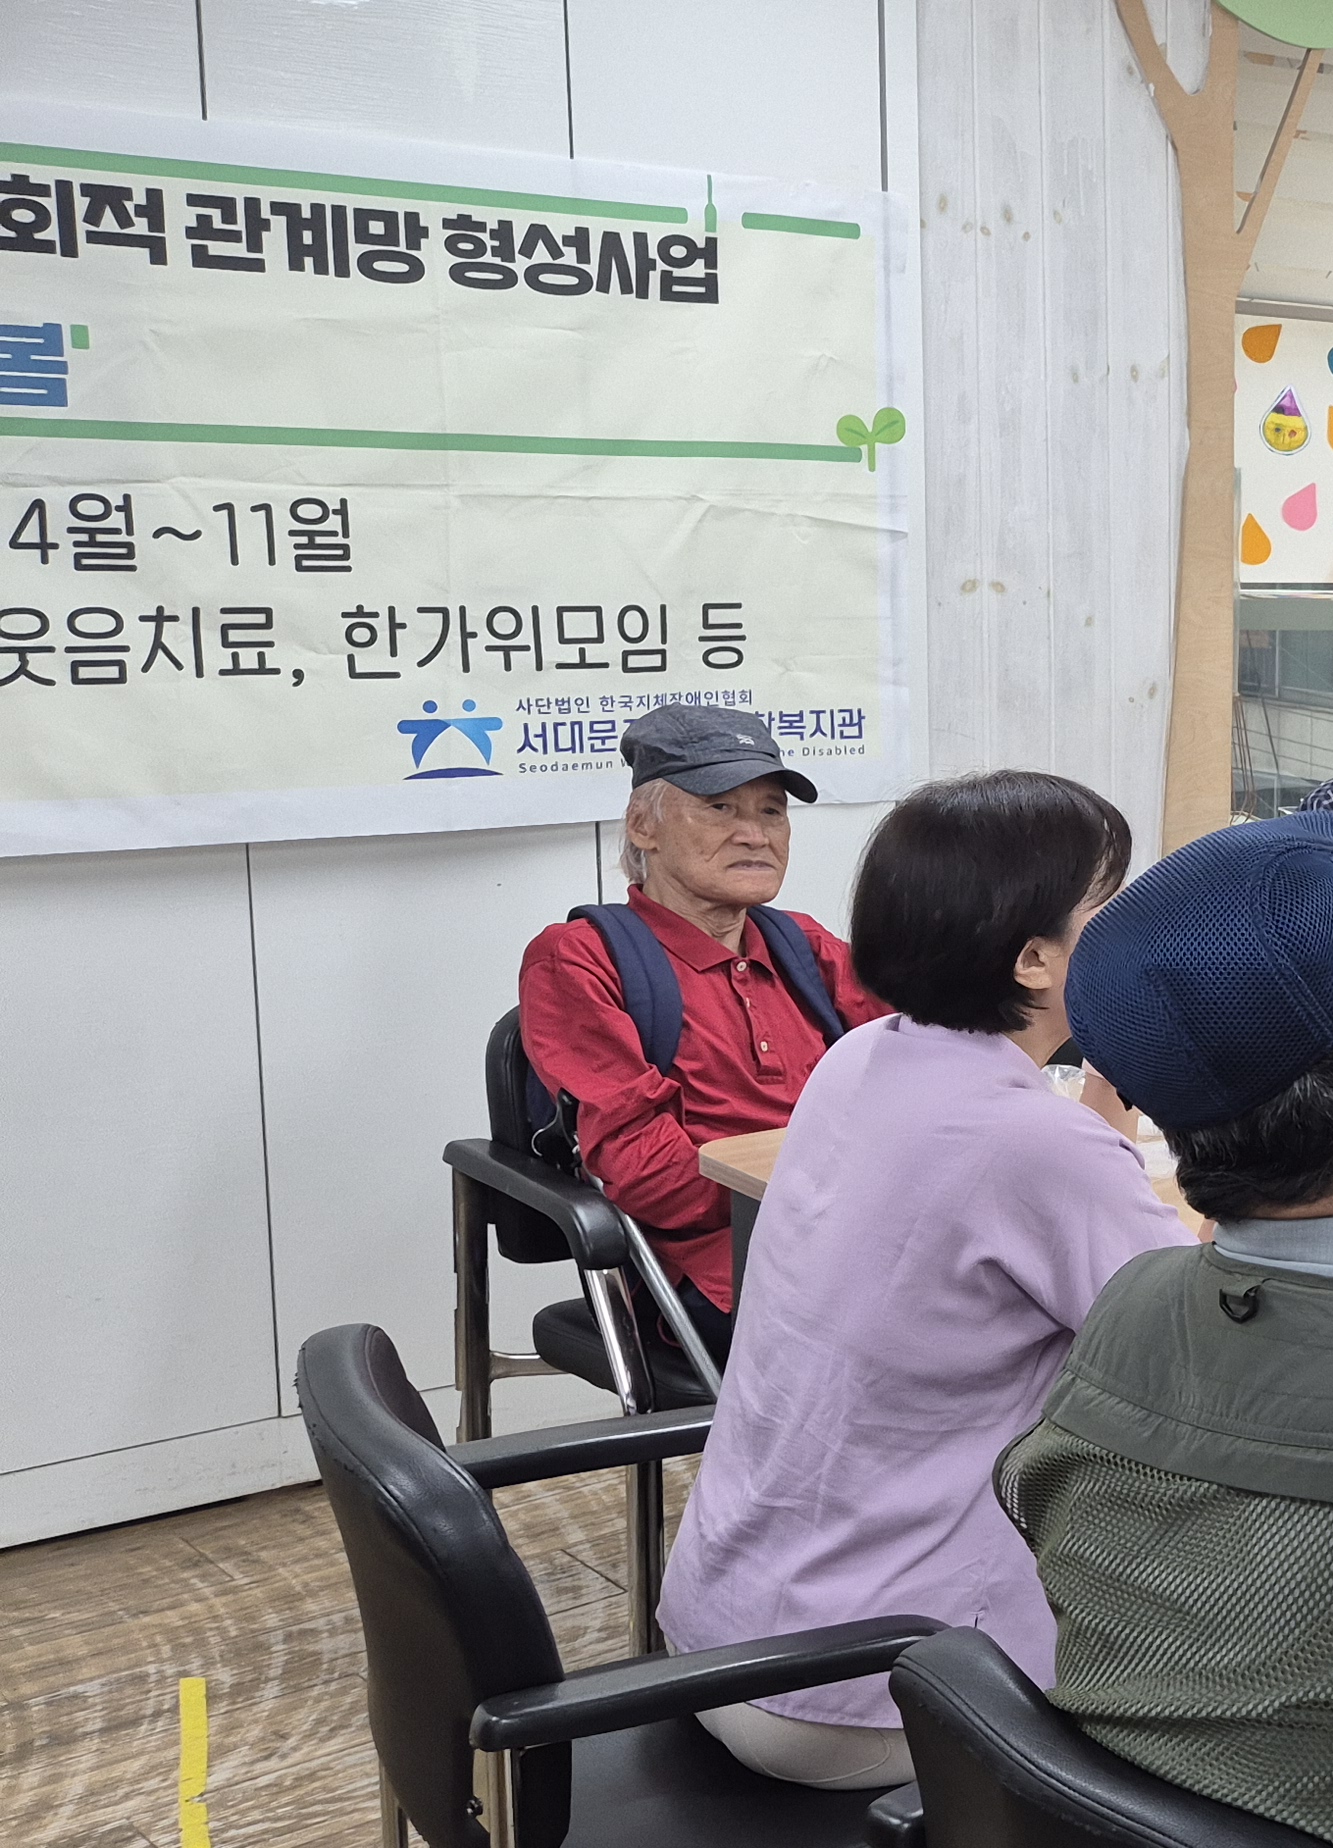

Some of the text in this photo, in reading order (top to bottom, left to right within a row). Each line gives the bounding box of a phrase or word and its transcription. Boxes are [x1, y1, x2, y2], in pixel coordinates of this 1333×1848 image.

[185, 193, 429, 284] 관계망
[442, 213, 719, 304] 형성사업
[341, 603, 668, 679] 한가위모임
[698, 602, 747, 670] 등
[516, 696, 590, 715] 사단법인
[518, 761, 613, 774] Seodaemun
[802, 744, 865, 757] Disabled
